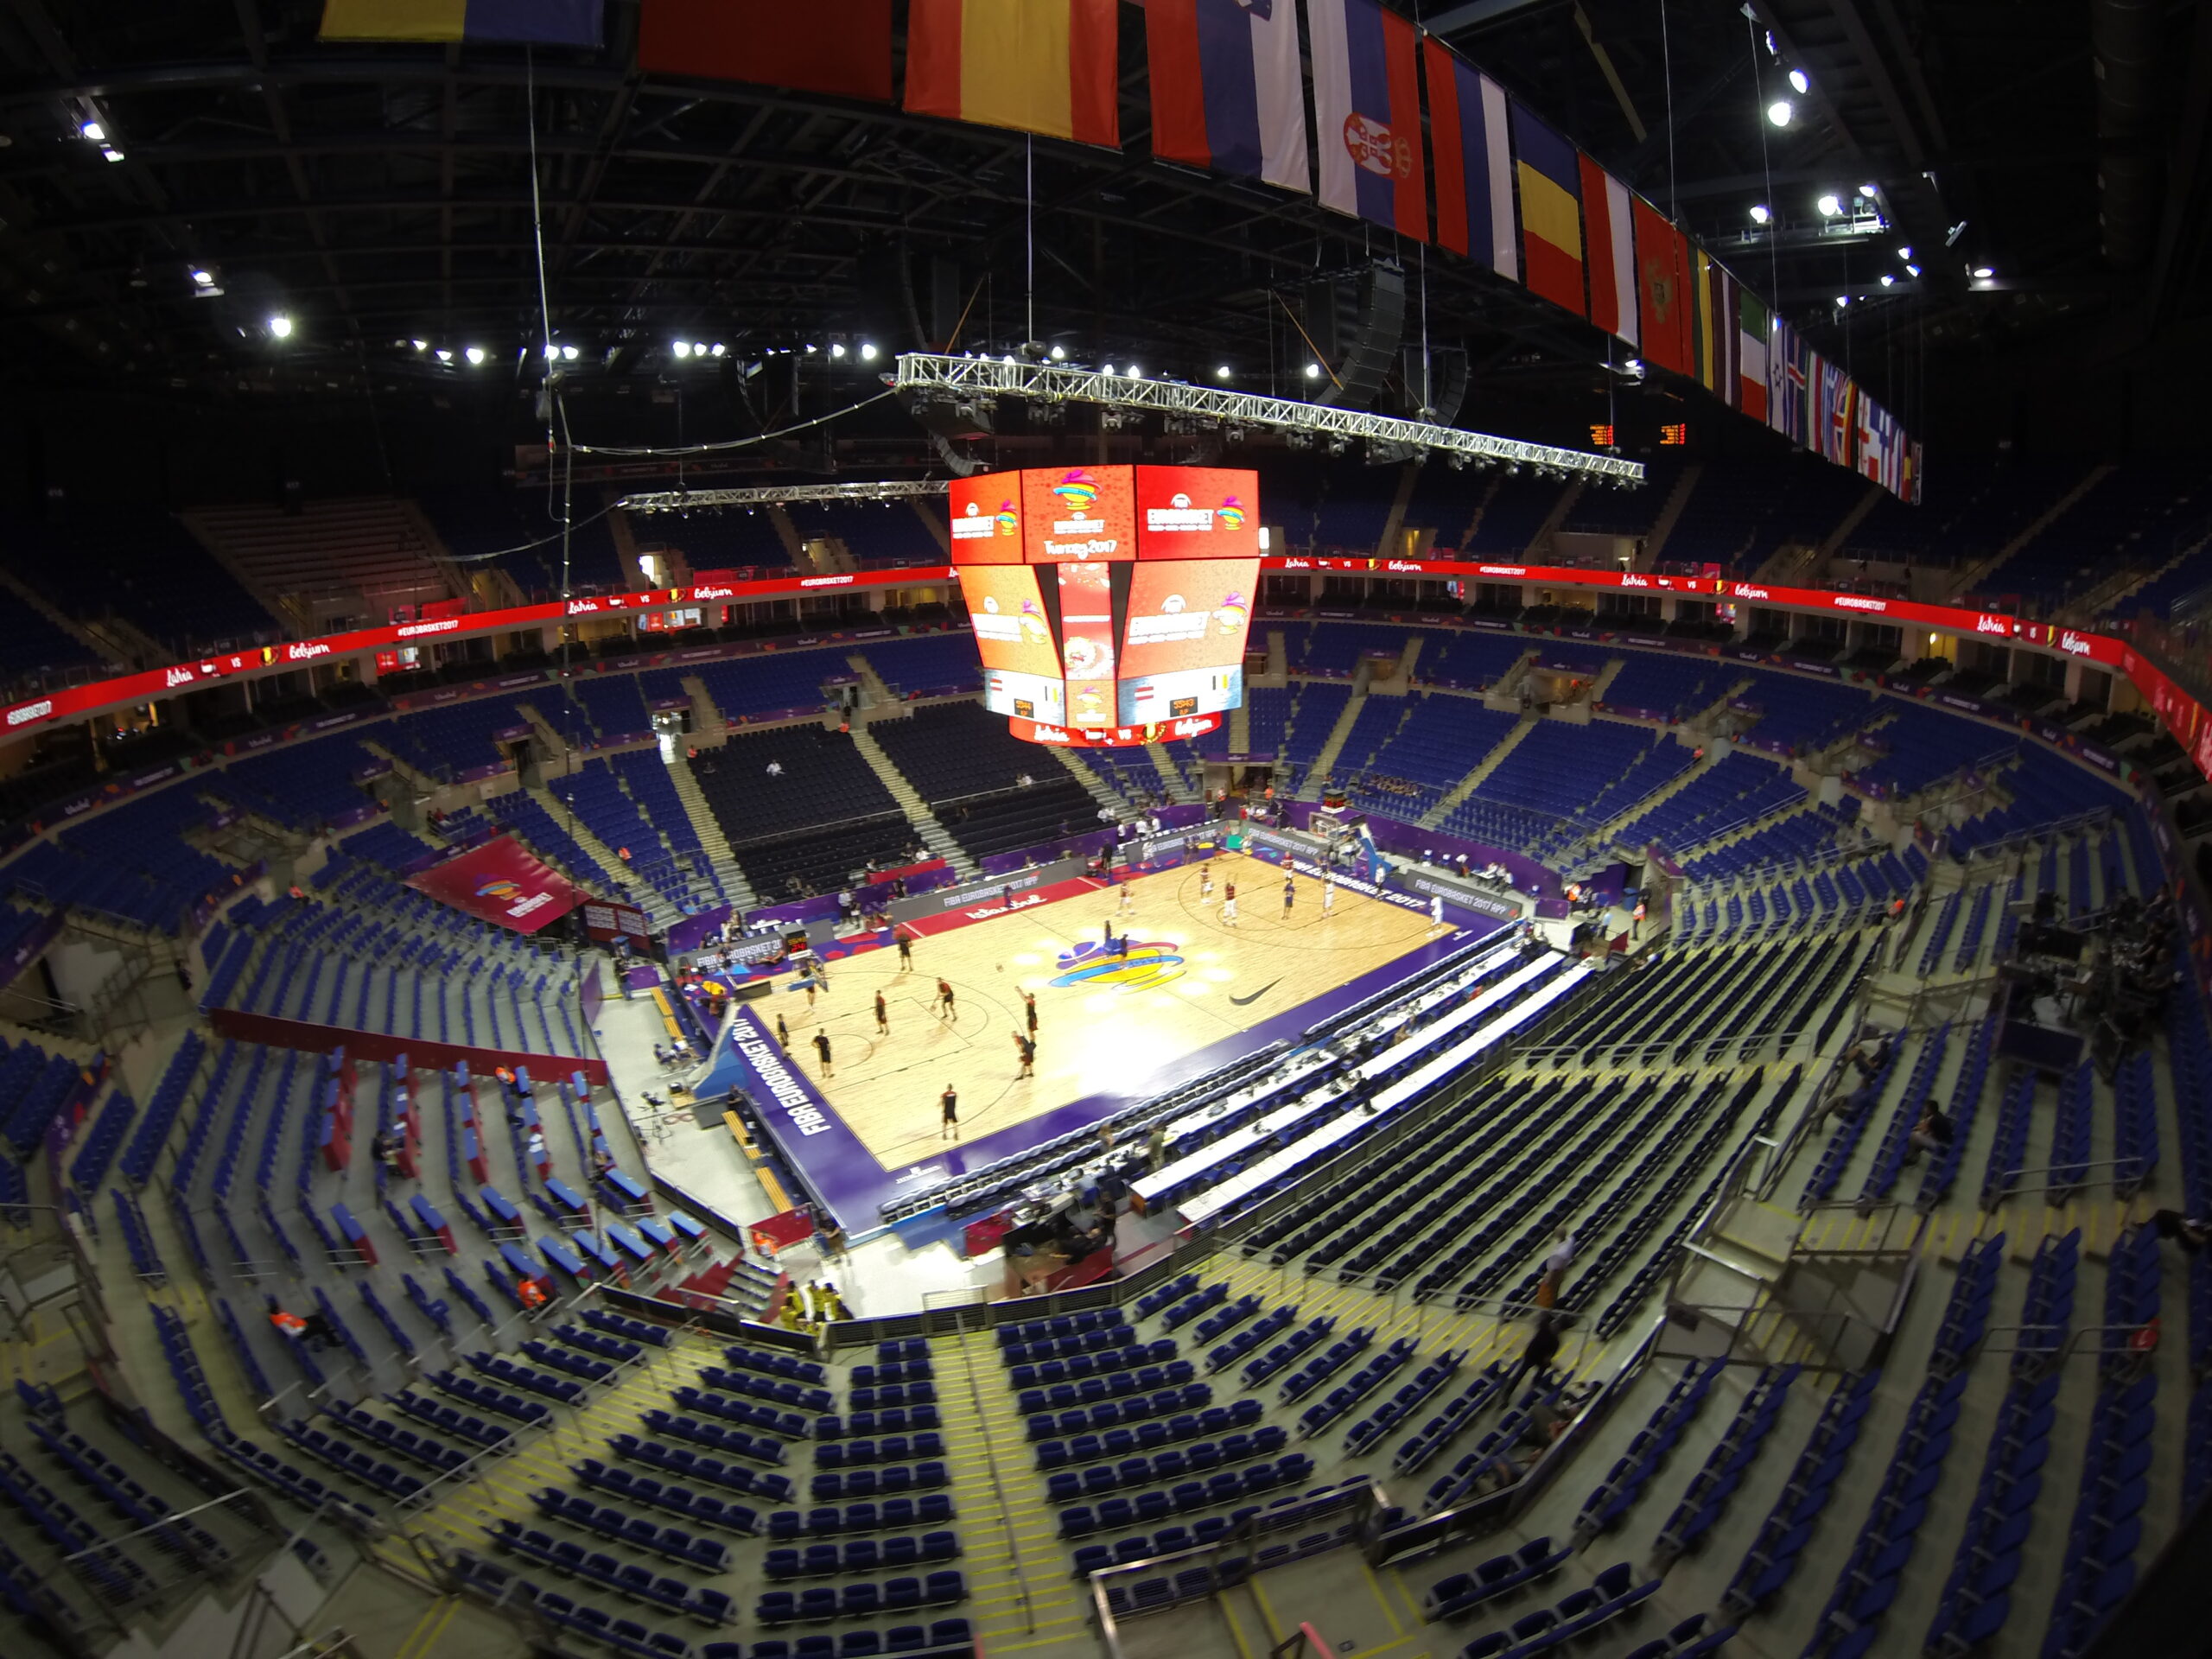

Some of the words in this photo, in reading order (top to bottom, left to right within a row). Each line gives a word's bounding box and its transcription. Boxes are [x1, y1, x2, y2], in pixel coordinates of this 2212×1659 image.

[1088, 539, 1117, 553] 2017
[1389, 560, 1421, 572] Belgium
[1621, 574, 1648, 587] Latvia
[569, 600, 599, 614] Latvia
[694, 587, 733, 599] Belgium
[289, 643, 329, 659] Belgium
[962, 884, 1007, 902] EUROBASKE
[1385, 892, 1427, 908] 2017
[1415, 879, 1431, 893] FIBA
[1430, 884, 1474, 905] EUROBASKET
[738, 1039, 810, 1109] EUROBASKET
[787, 1103, 832, 1136] FIBA
